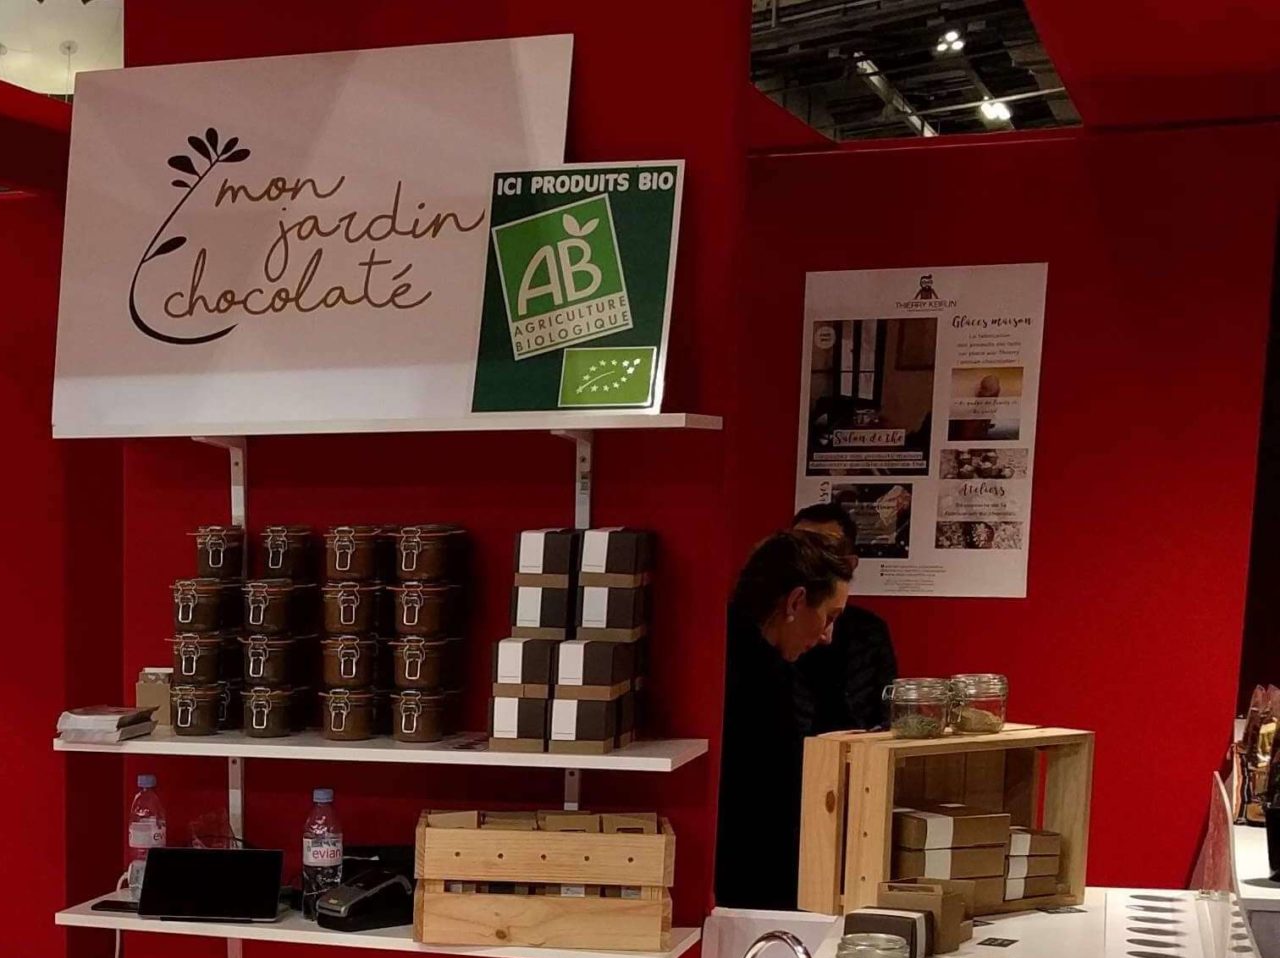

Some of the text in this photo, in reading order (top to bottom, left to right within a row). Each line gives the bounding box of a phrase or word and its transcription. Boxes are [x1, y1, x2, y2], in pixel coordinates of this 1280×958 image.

[215, 176, 345, 207] mon
[497, 171, 674, 196] ICI PRODUITS BIO
[264, 181, 486, 283] jardin
[164, 248, 433, 318] chocolaté
[517, 238, 603, 316] AB
[514, 295, 627, 338] AGRICULTURE
[515, 310, 630, 351] BIOLOGIQUE
[312, 846, 341, 859] evian
